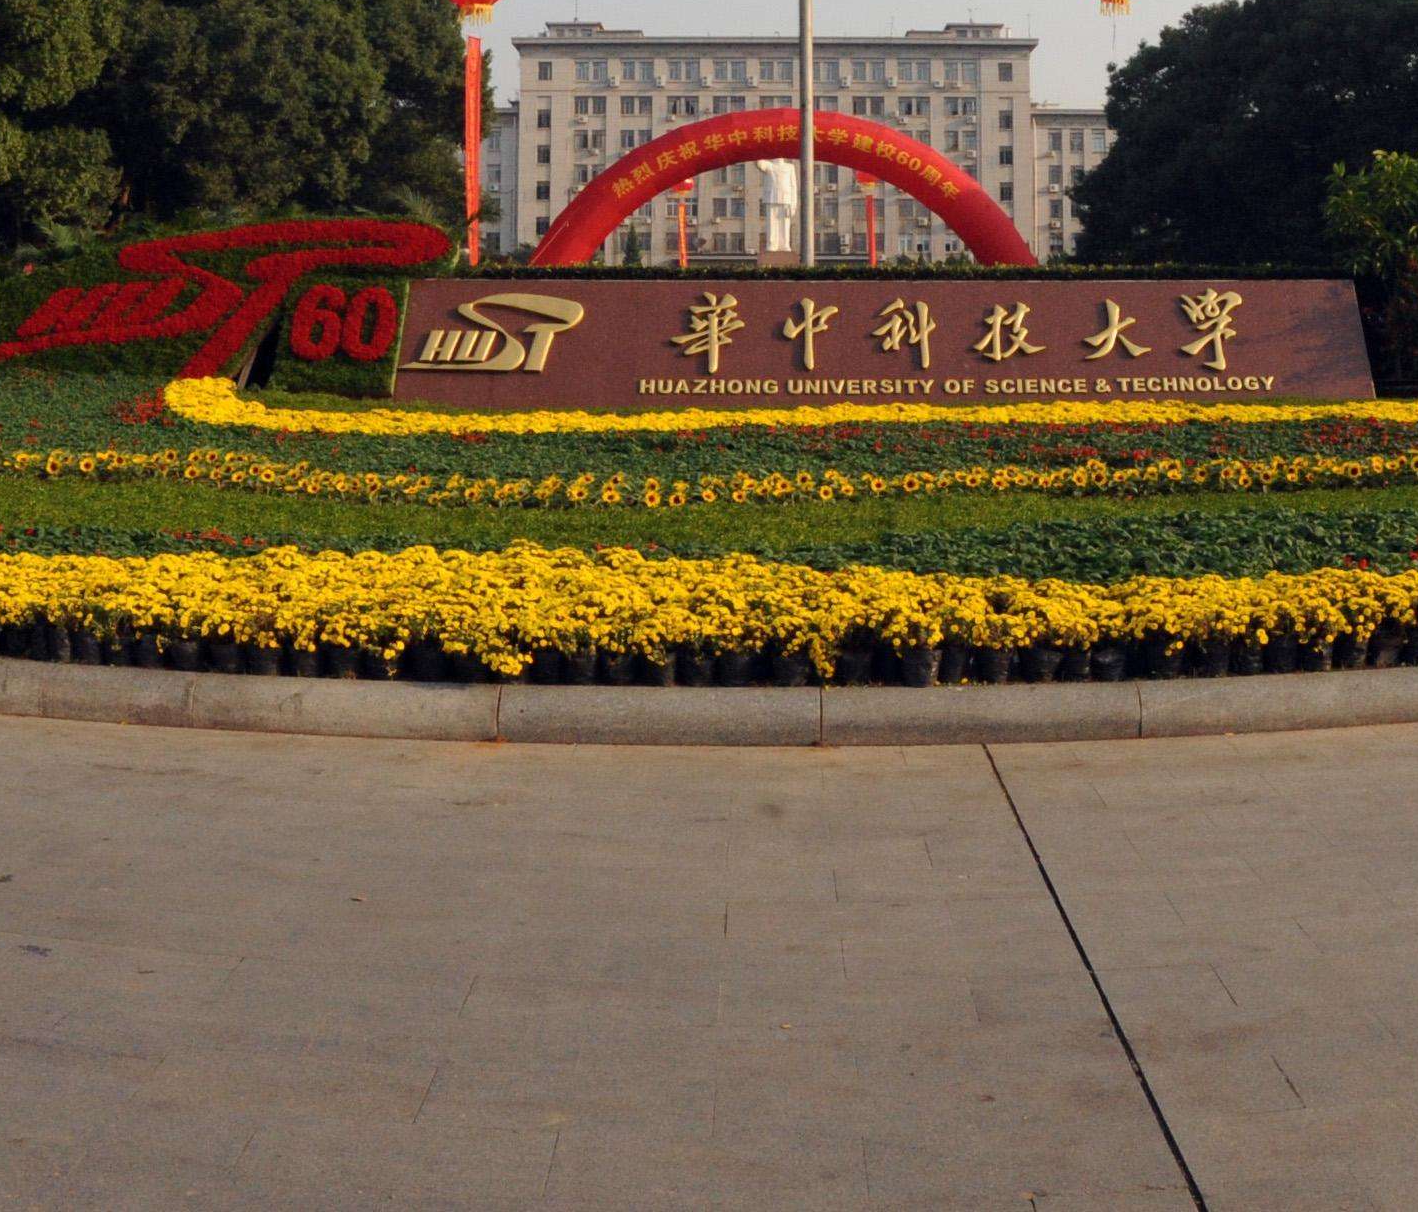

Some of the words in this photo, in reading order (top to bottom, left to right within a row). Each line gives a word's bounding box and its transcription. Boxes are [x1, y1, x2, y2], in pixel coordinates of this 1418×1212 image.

[289, 284, 397, 361] 60
[638, 379, 779, 395] HUAZHONG
[787, 379, 934, 395] UNIVERSITY
[944, 379, 975, 395] OF
[985, 378, 1088, 394] SCIENCE
[1095, 378, 1112, 394] &
[1116, 375, 1275, 393] TECHNOLOGY
